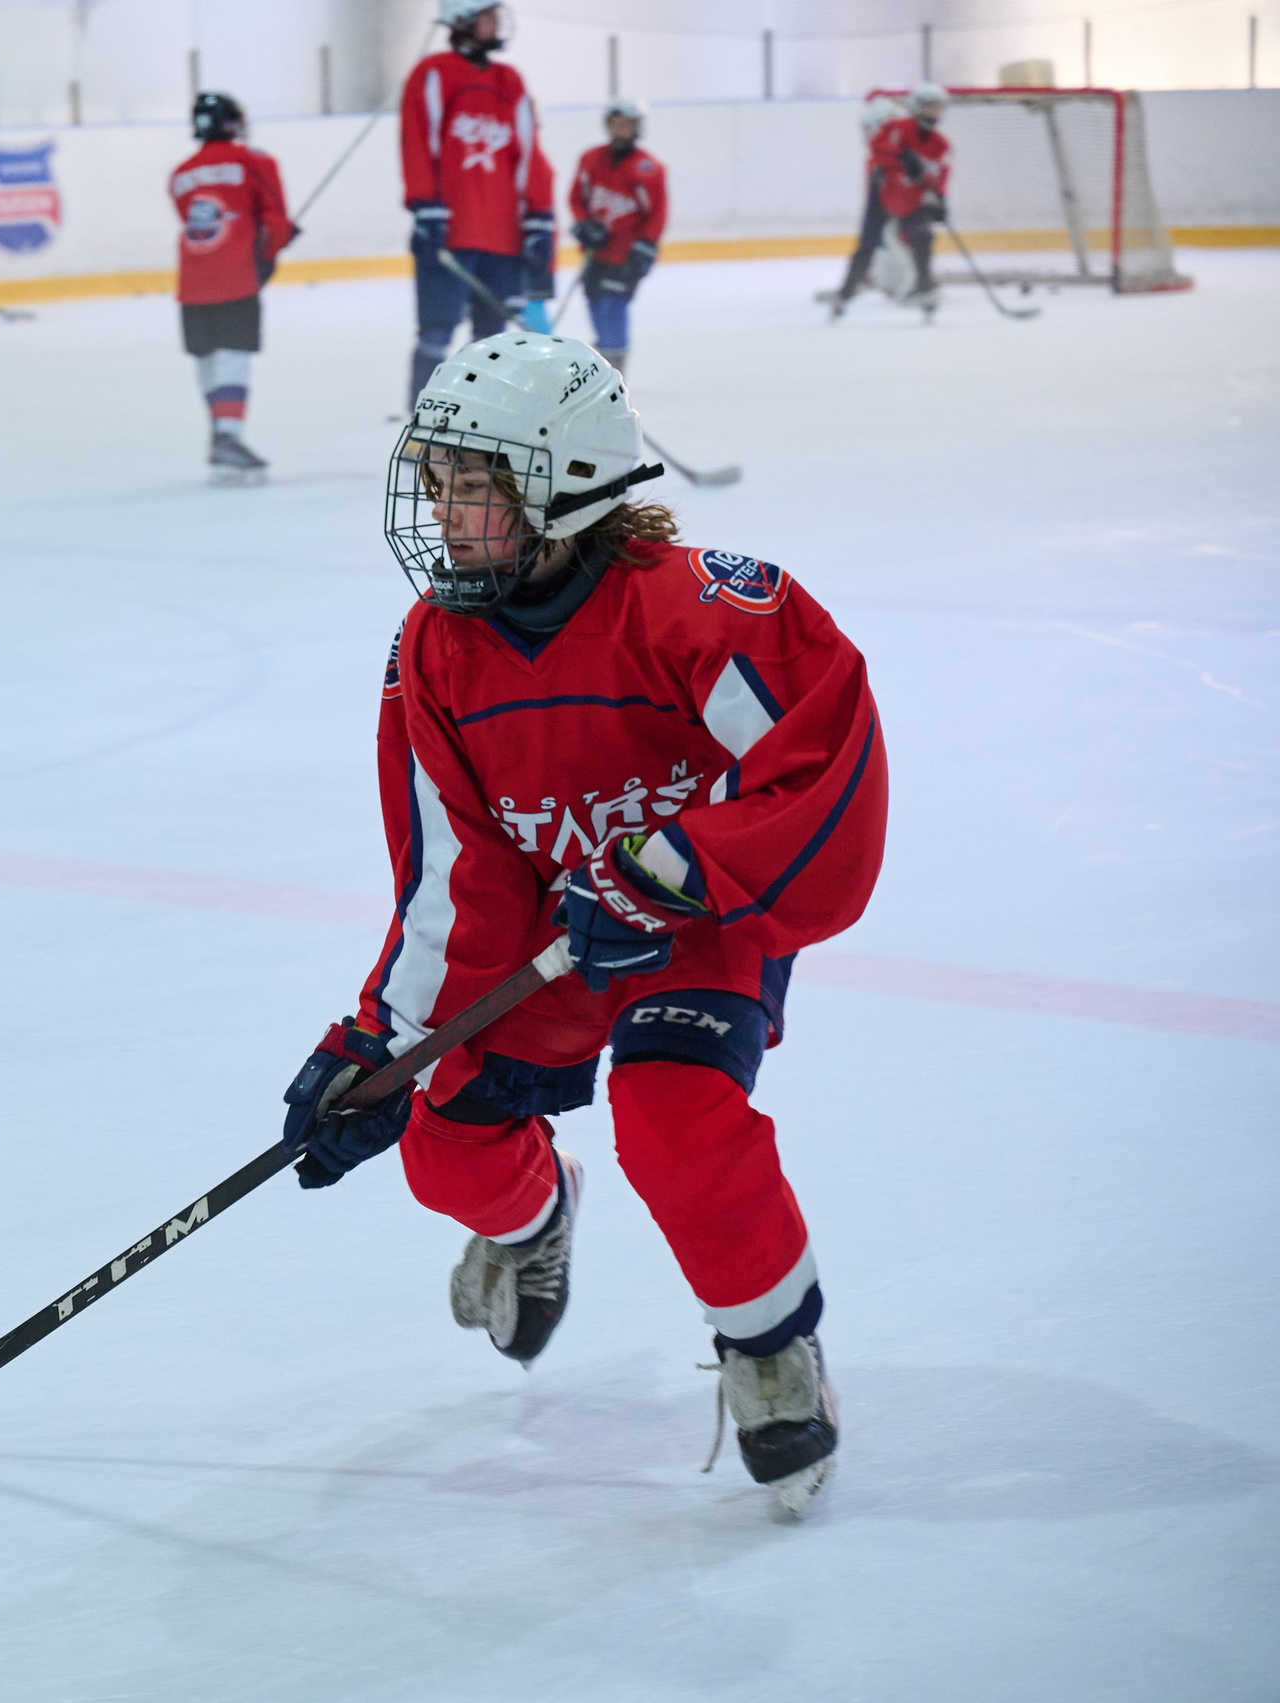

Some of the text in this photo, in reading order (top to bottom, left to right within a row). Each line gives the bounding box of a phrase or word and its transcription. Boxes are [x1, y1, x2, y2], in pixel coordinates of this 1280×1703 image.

[559, 363, 599, 404] JOFA
[417, 398, 461, 416] JOFA
[499, 759, 687, 810] OSTON
[488, 774, 704, 865] TARS
[631, 1006, 732, 1037] CCM
